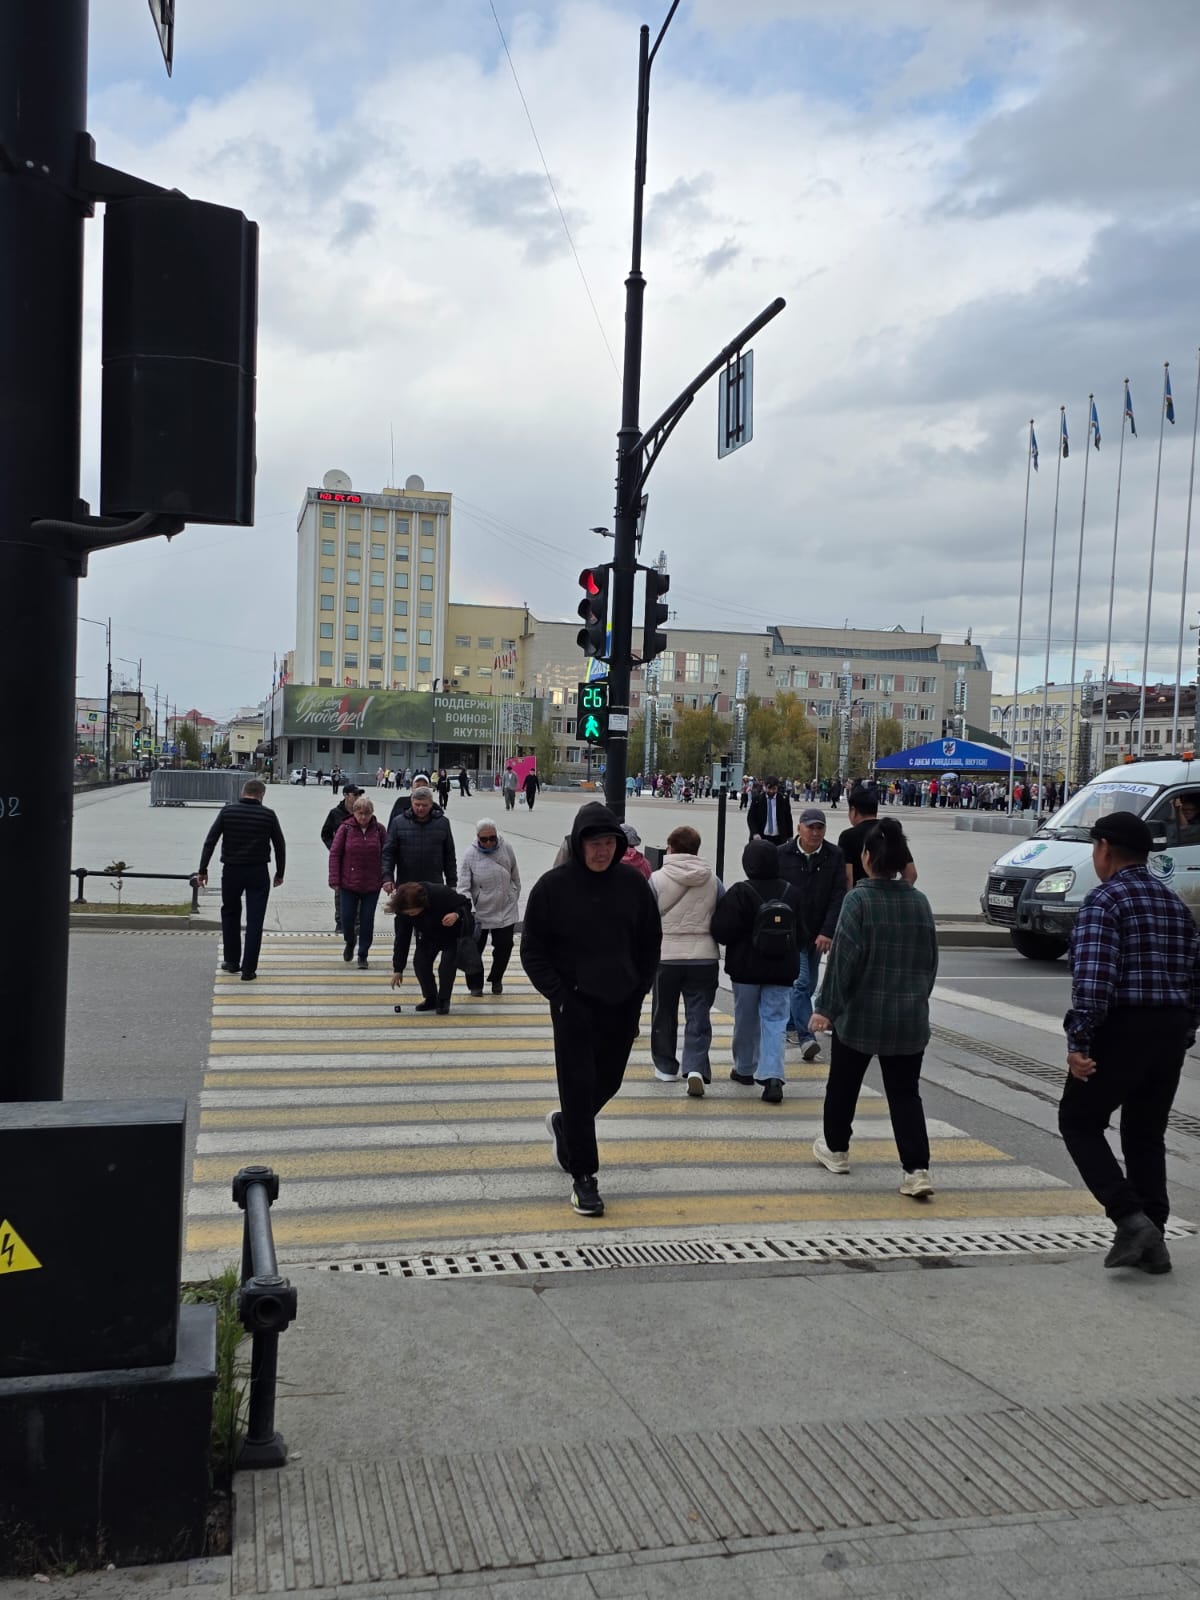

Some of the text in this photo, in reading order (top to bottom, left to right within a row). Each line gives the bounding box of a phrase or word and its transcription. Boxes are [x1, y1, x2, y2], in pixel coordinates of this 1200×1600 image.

[434, 697, 493, 710] ПОДДЕРЖИ
[583, 688, 602, 708] 26
[445, 713, 493, 724] ВОИНОВ-
[453, 727, 493, 739] ЯКУТЯН
